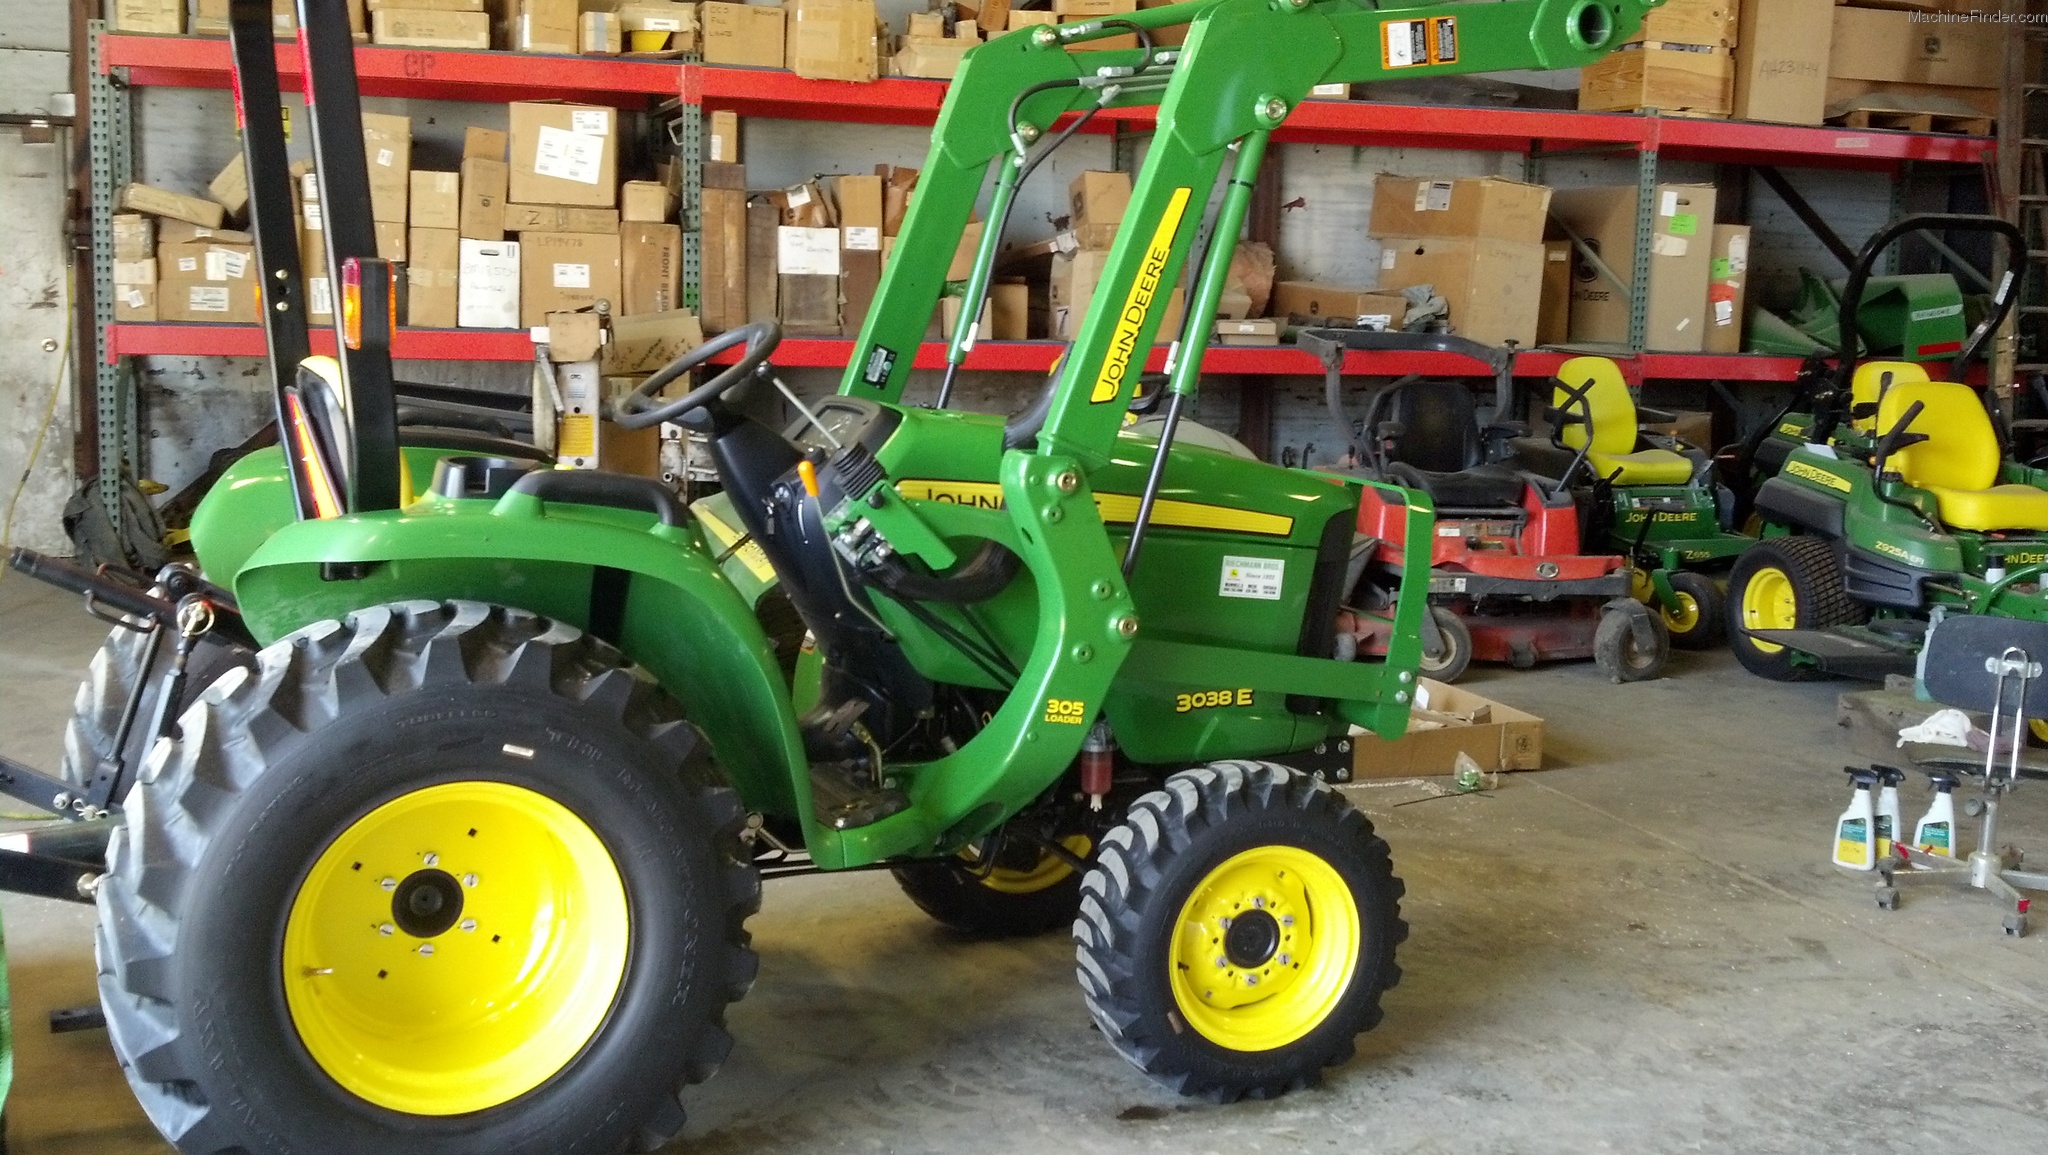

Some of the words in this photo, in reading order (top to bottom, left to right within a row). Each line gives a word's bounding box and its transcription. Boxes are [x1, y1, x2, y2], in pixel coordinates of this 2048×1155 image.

[661, 246, 671, 279] FRONT
[1102, 329, 1135, 396] JOHN
[1124, 247, 1167, 327] DEERE
[1791, 465, 1811, 478] JOHN
[1810, 469, 1837, 487] DEERE
[1659, 511, 1698, 522] DEERE
[1875, 540, 1909, 560] Z925A
[2004, 554, 2019, 564] HN
[2020, 552, 2045, 564] DEE
[1046, 699, 1085, 716] 305
[1176, 690, 1233, 713] 3038
[1236, 688, 1254, 706] E
[1044, 714, 1083, 725] LOADER
